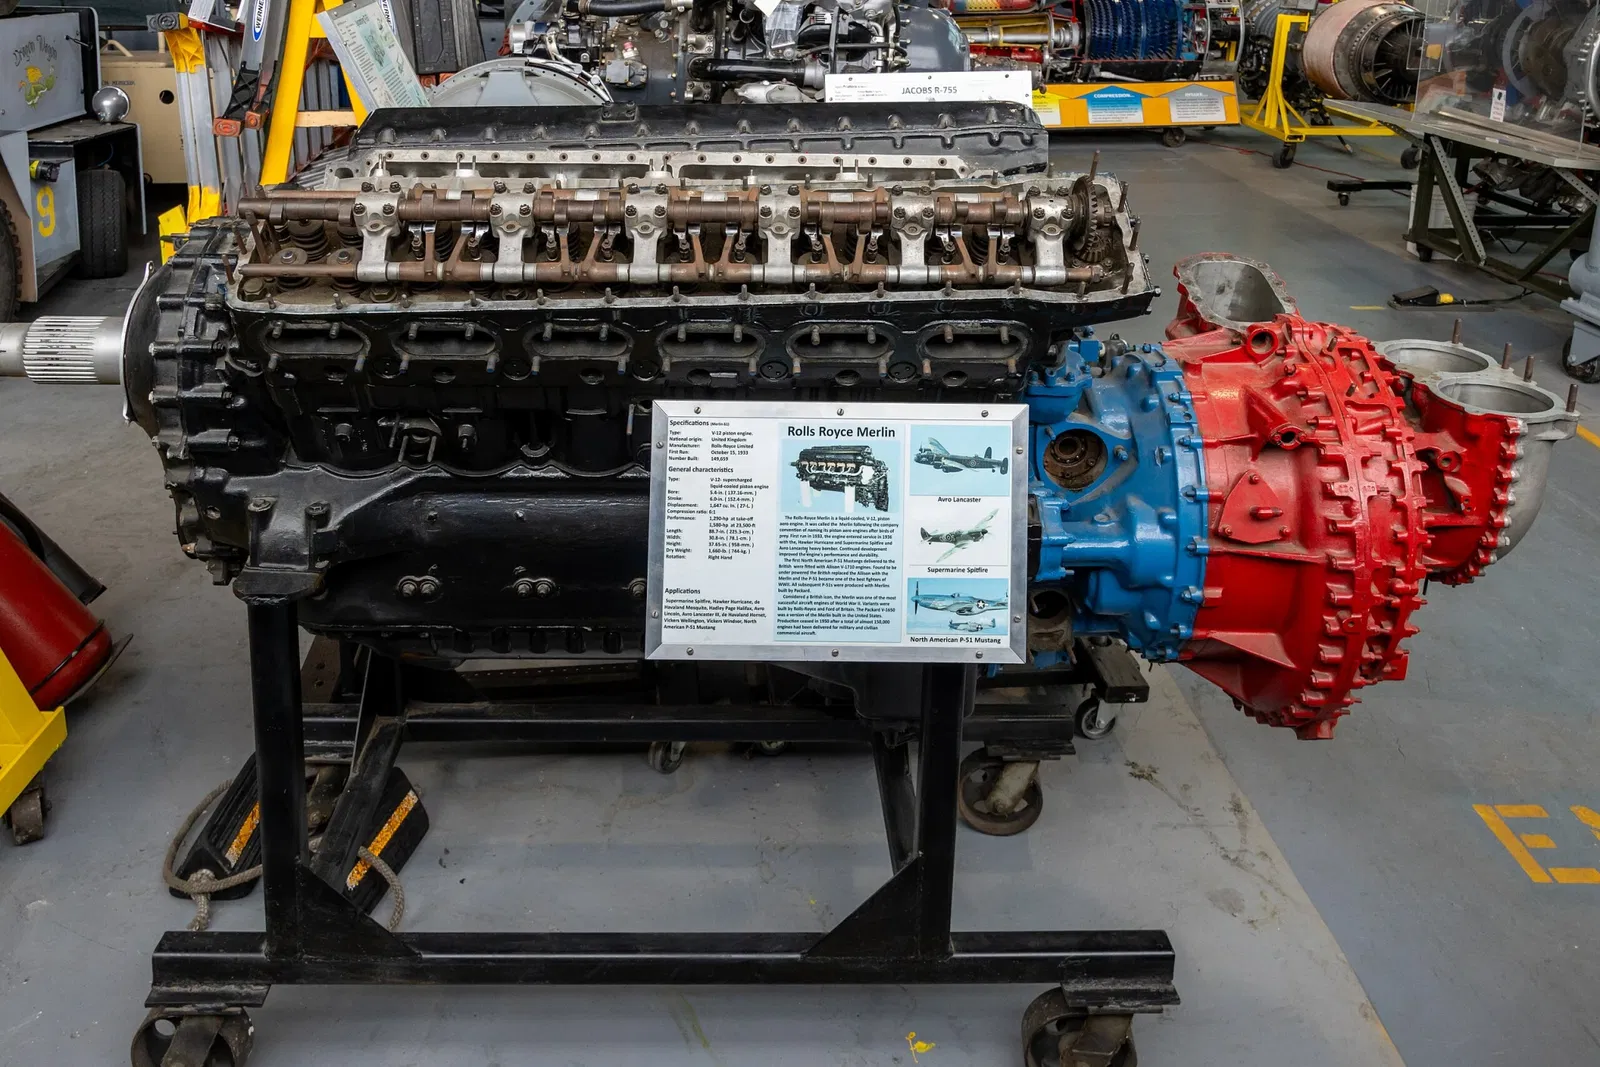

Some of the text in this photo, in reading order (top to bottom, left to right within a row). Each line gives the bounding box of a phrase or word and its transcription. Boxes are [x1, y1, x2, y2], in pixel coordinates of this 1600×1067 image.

[256, 0, 264, 28] WERNE
[902, 86, 958, 94] JACOBS R-755
[36, 186, 56, 238] 9
[788, 425, 895, 439] Rolls Royce Merlin
